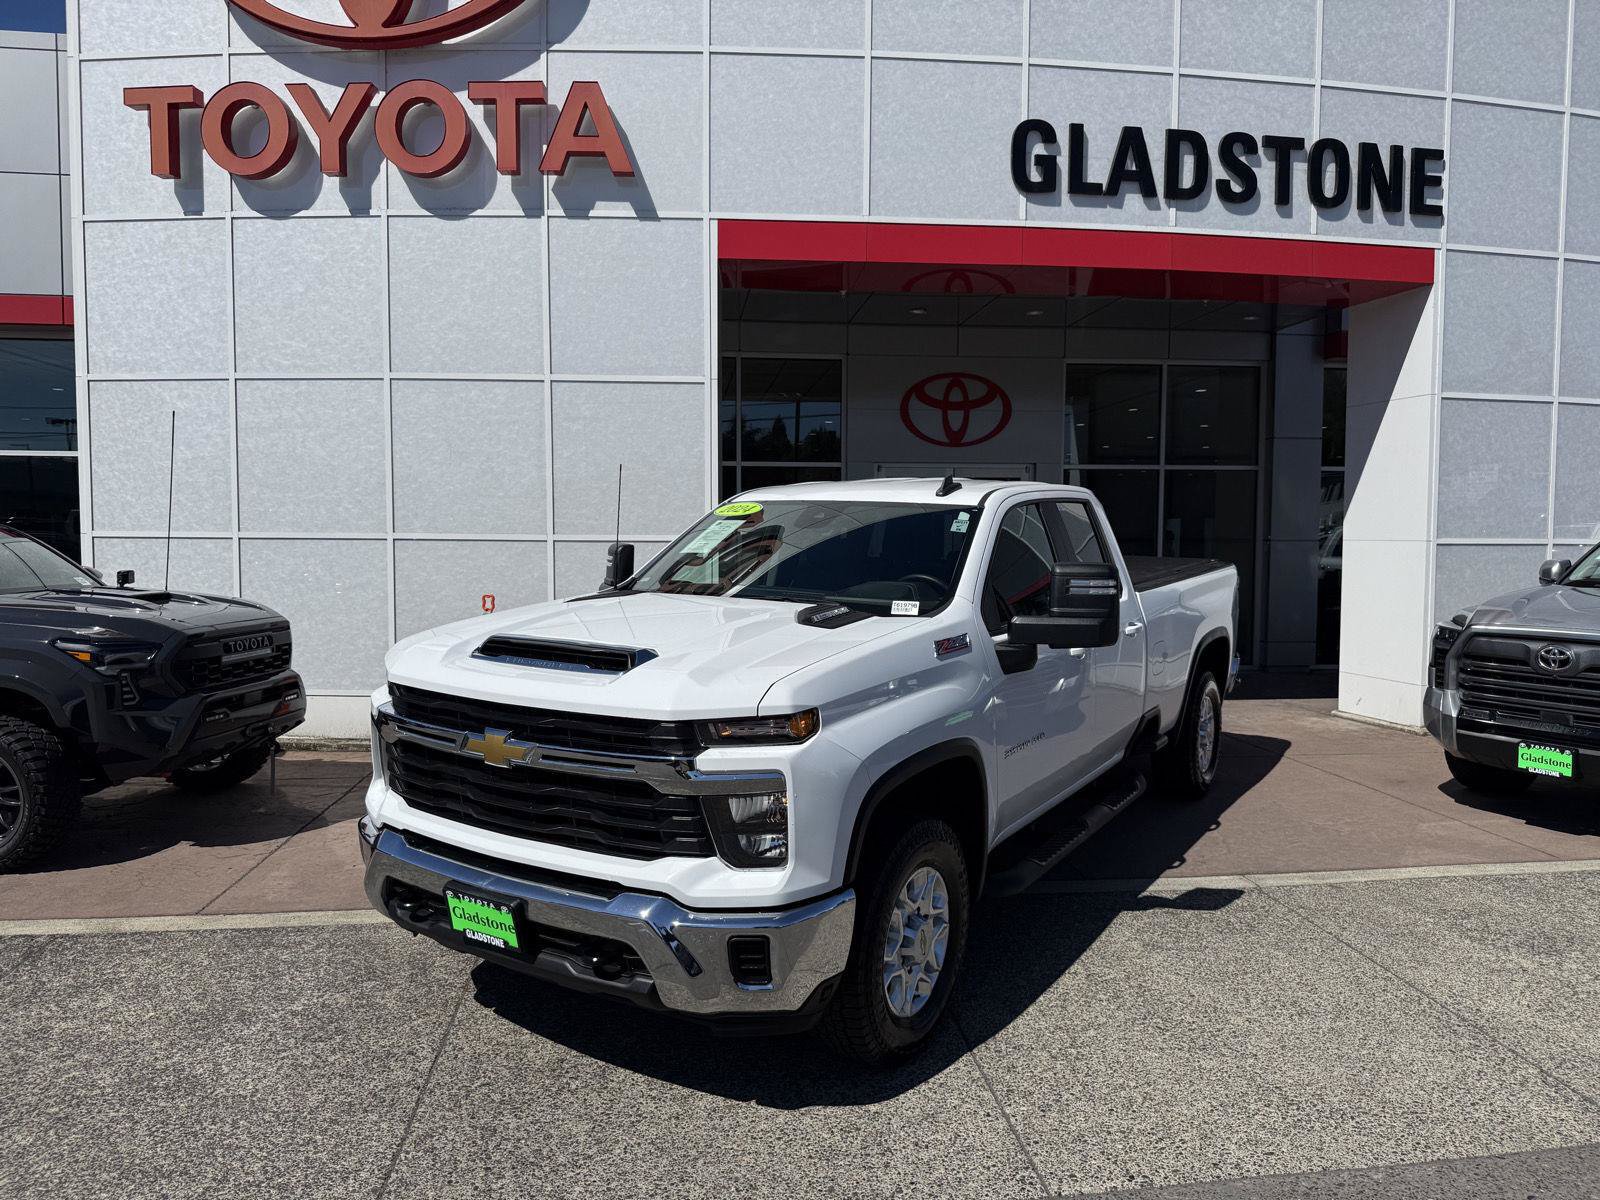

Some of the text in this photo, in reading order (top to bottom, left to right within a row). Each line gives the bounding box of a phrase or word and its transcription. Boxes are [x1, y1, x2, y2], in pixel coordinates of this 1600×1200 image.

[123, 80, 635, 180] TOYOTA
[1011, 118, 1445, 217] GLADSTONE
[229, 636, 270, 652] TOYOTA
[1530, 744, 1560, 753] TOYOTA
[1520, 752, 1571, 769] Gladstone
[1528, 766, 1560, 777] GLADSTONE
[458, 893, 495, 908] TOYOTA
[452, 905, 516, 934] Gladstone
[465, 929, 505, 948] GLADSTONE
